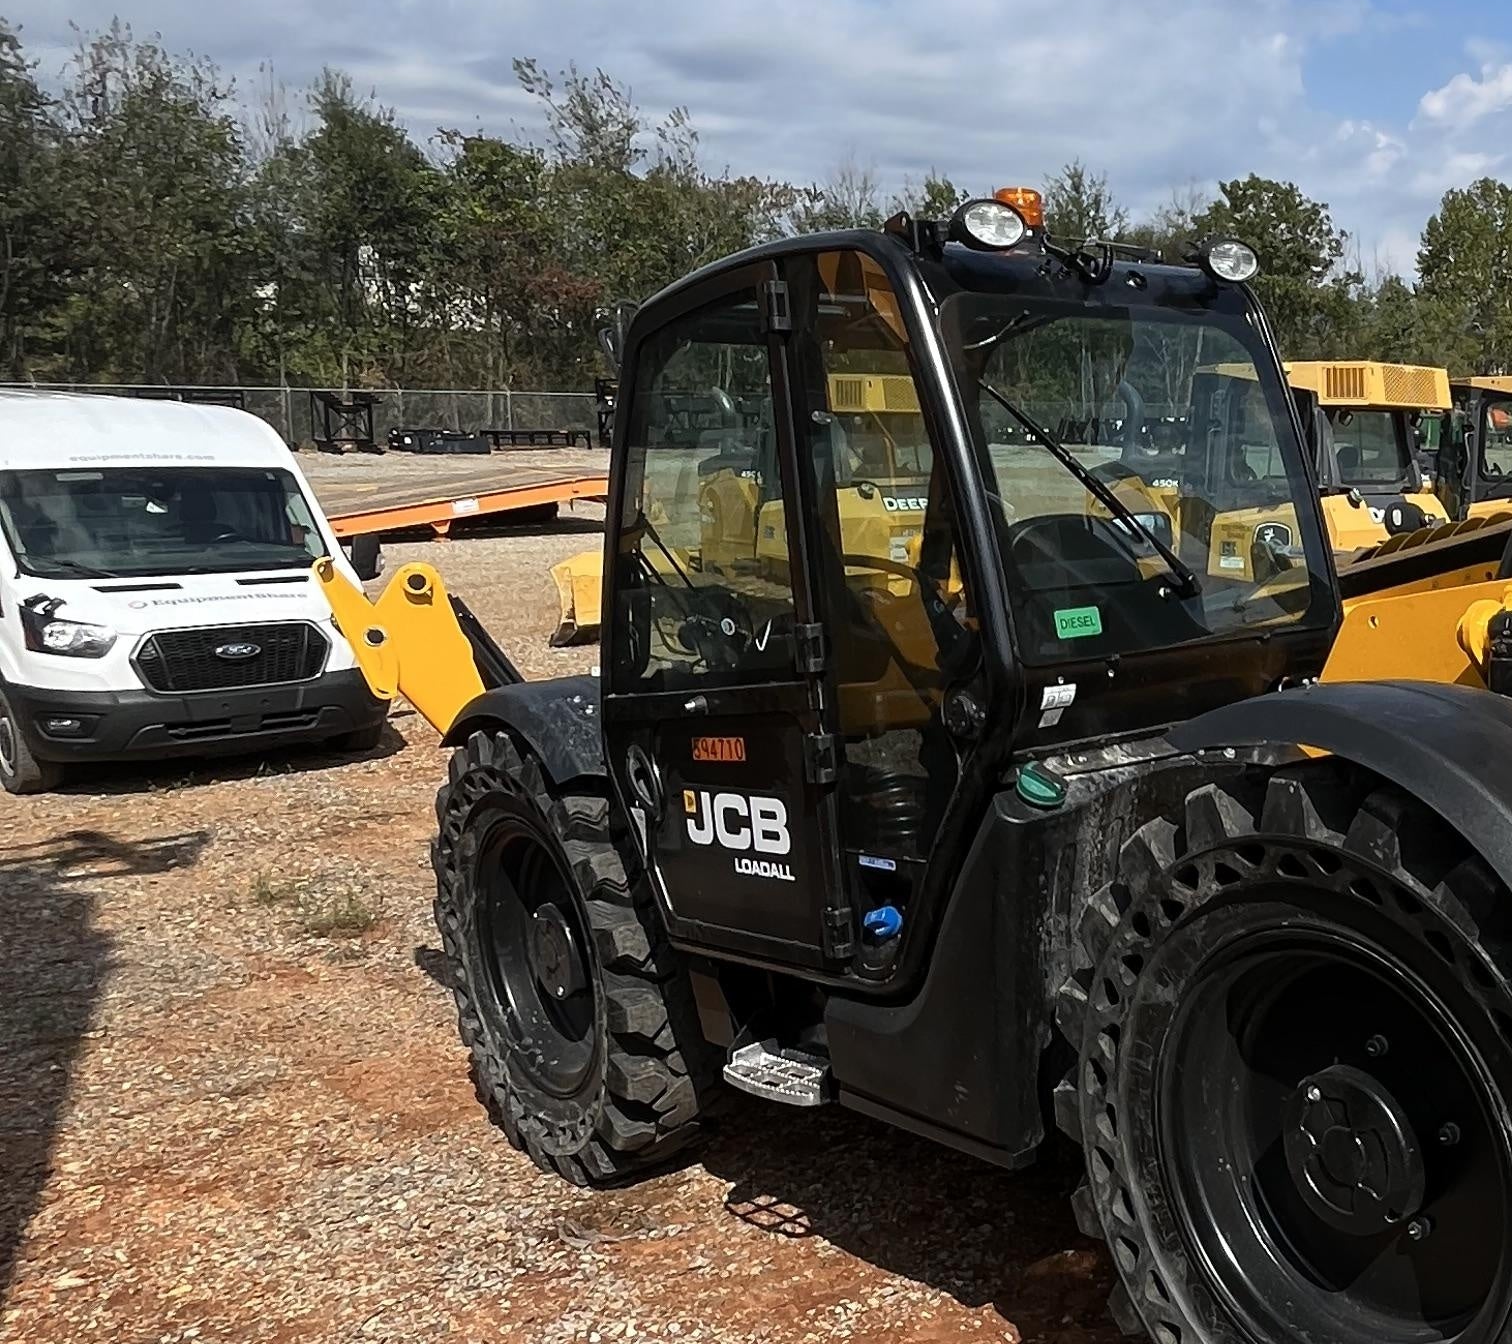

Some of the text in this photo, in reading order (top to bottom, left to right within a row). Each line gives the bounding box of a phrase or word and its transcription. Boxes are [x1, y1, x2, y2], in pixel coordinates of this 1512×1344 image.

[1152, 479, 1179, 488] 450K
[151, 592, 307, 605] EquipmentShare
[1060, 615, 1095, 629] DIESEL
[694, 738, 743, 759] 594710
[687, 791, 791, 855] JCB
[735, 857, 796, 881] LOADALL
